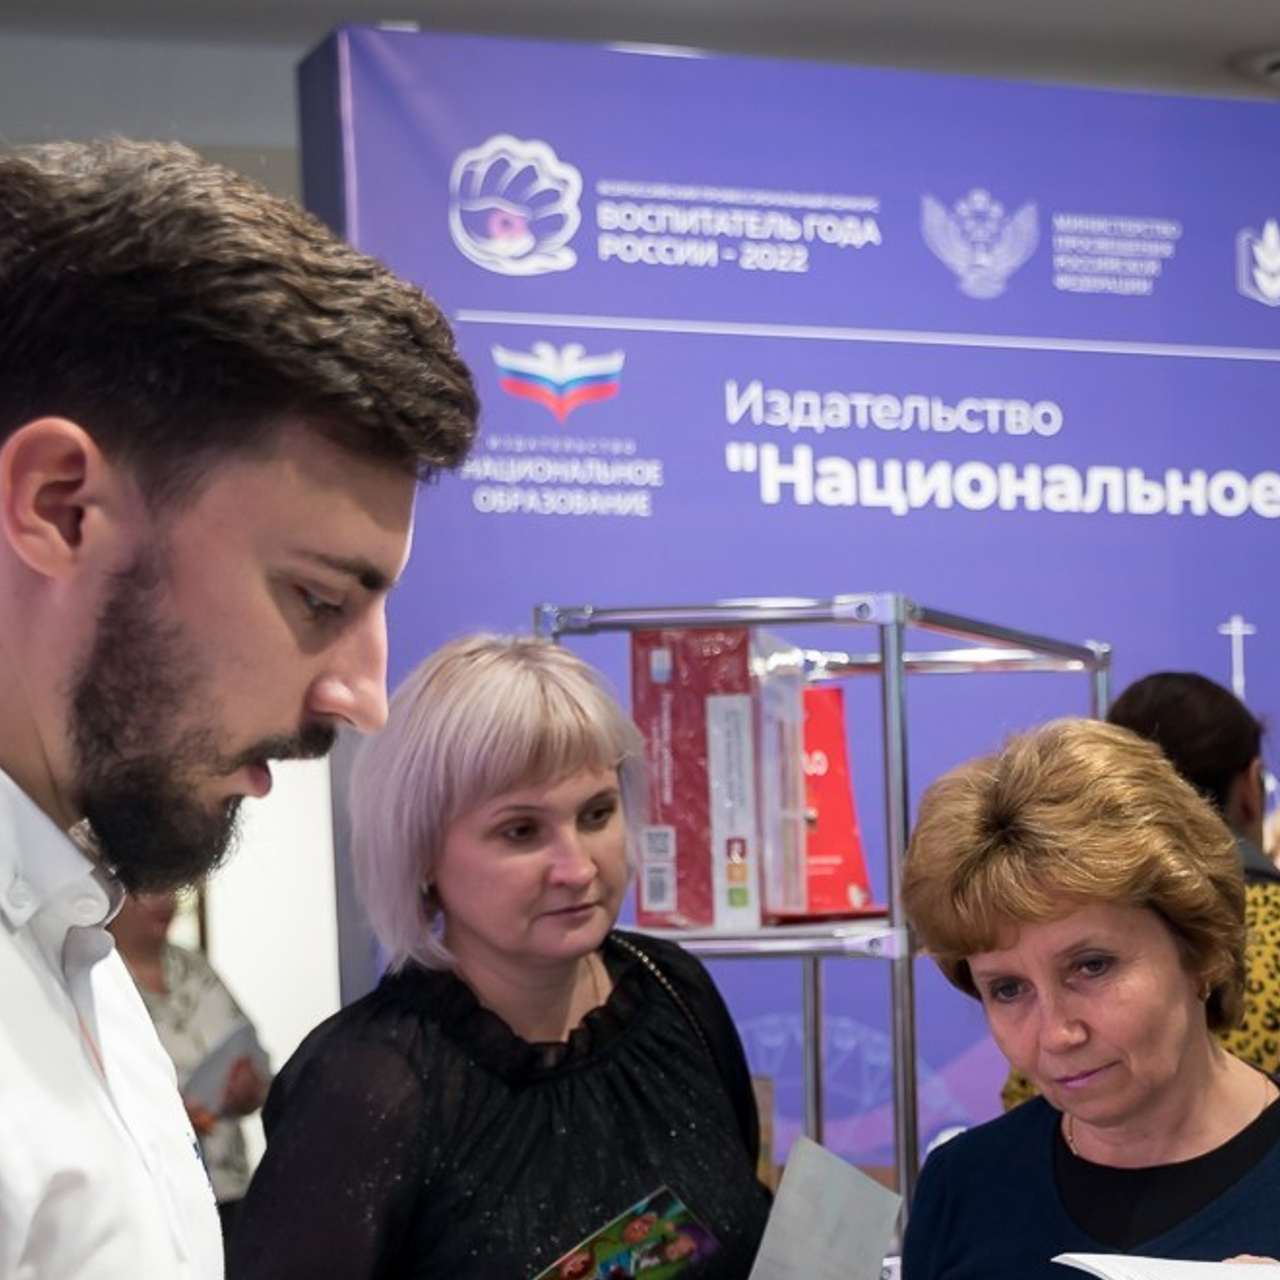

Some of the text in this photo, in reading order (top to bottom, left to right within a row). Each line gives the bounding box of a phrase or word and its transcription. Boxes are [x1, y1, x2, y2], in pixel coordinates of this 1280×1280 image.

[597, 200, 882, 248] ВОСПИТАТЕЛЬ ГОДА
[598, 232, 718, 267] РОССИИ
[739, 241, 809, 272] 2022
[725, 379, 1063, 436] Издательство
